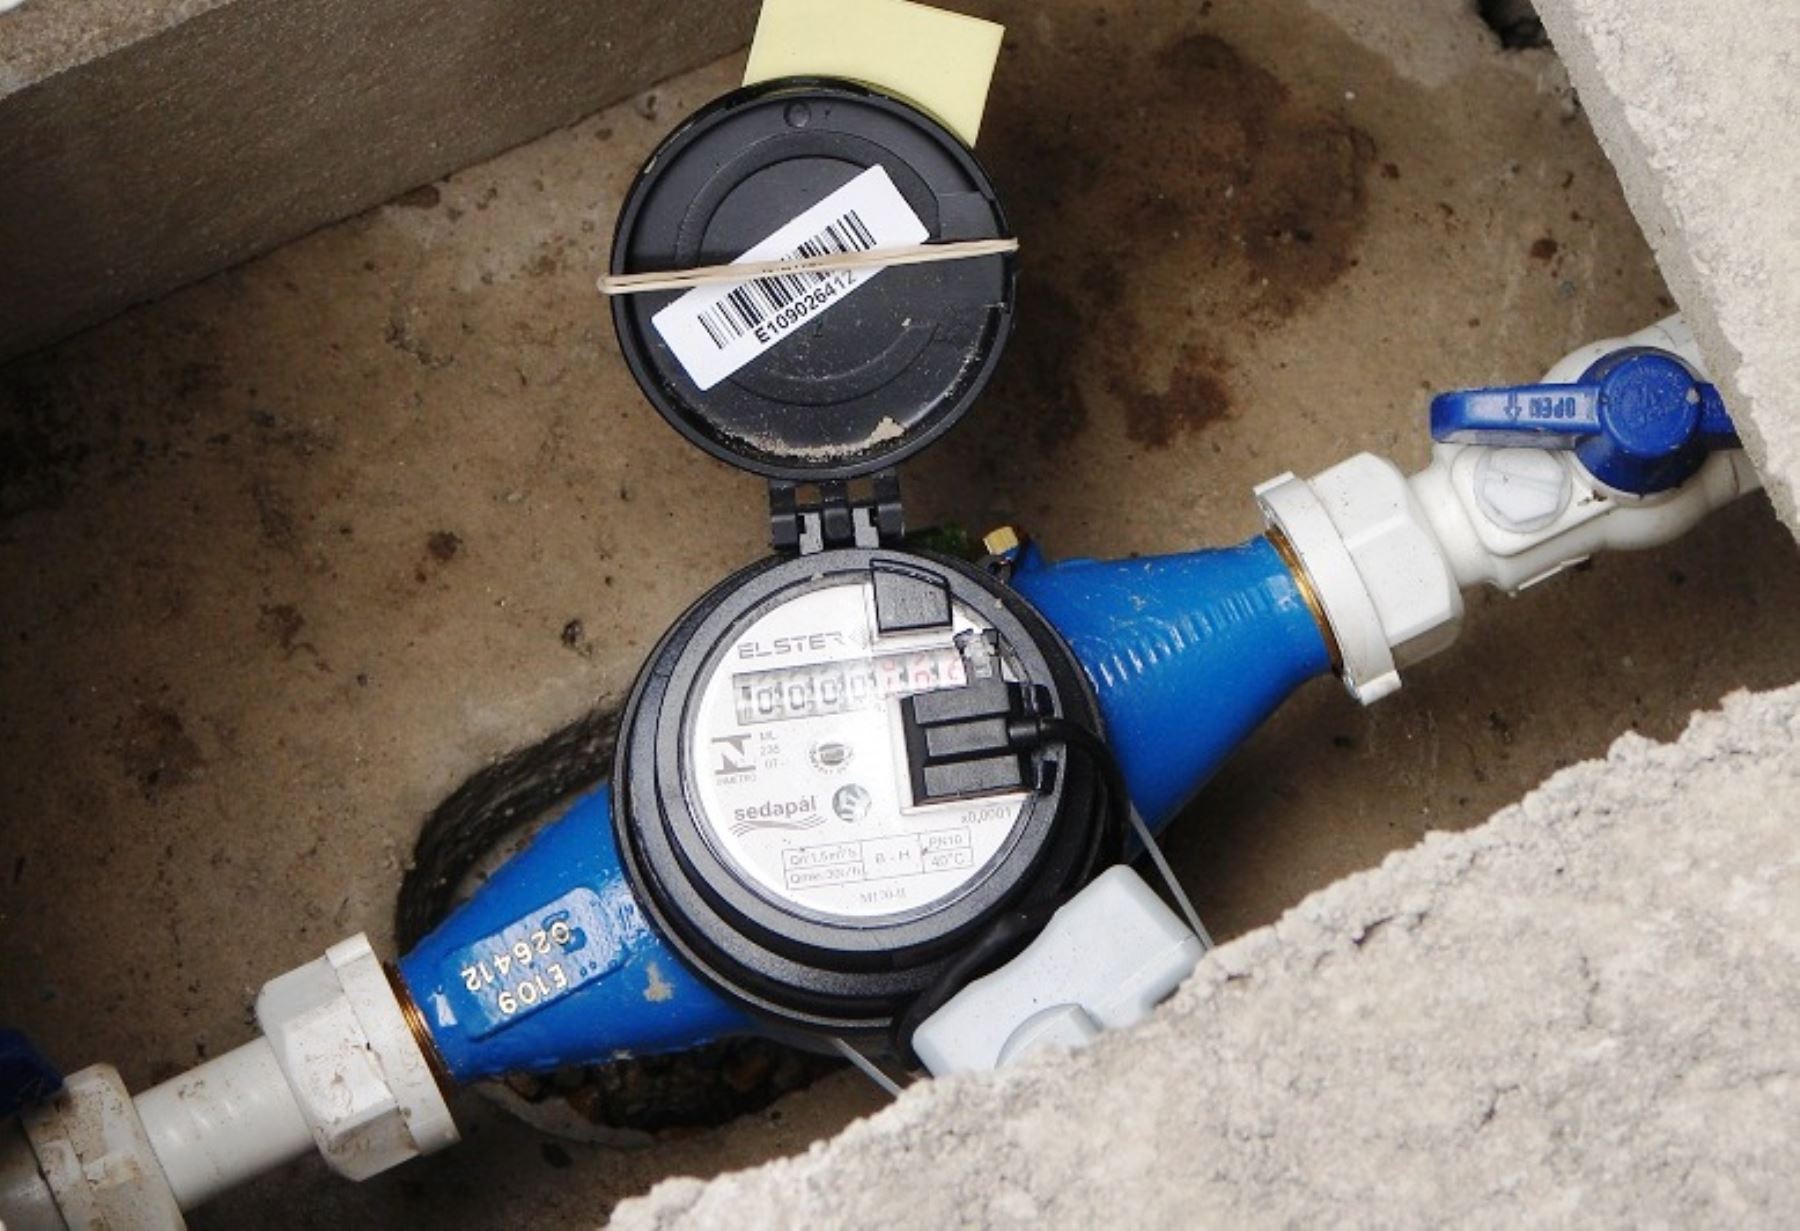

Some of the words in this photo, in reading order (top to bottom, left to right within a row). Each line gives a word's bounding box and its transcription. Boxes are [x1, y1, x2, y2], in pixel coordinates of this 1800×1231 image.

[753, 272, 858, 345] E109026412
[1528, 397, 1577, 419] OPEN
[738, 630, 845, 660] ELSTER
[460, 921, 571, 990] 026412
[499, 963, 567, 1014] E109
